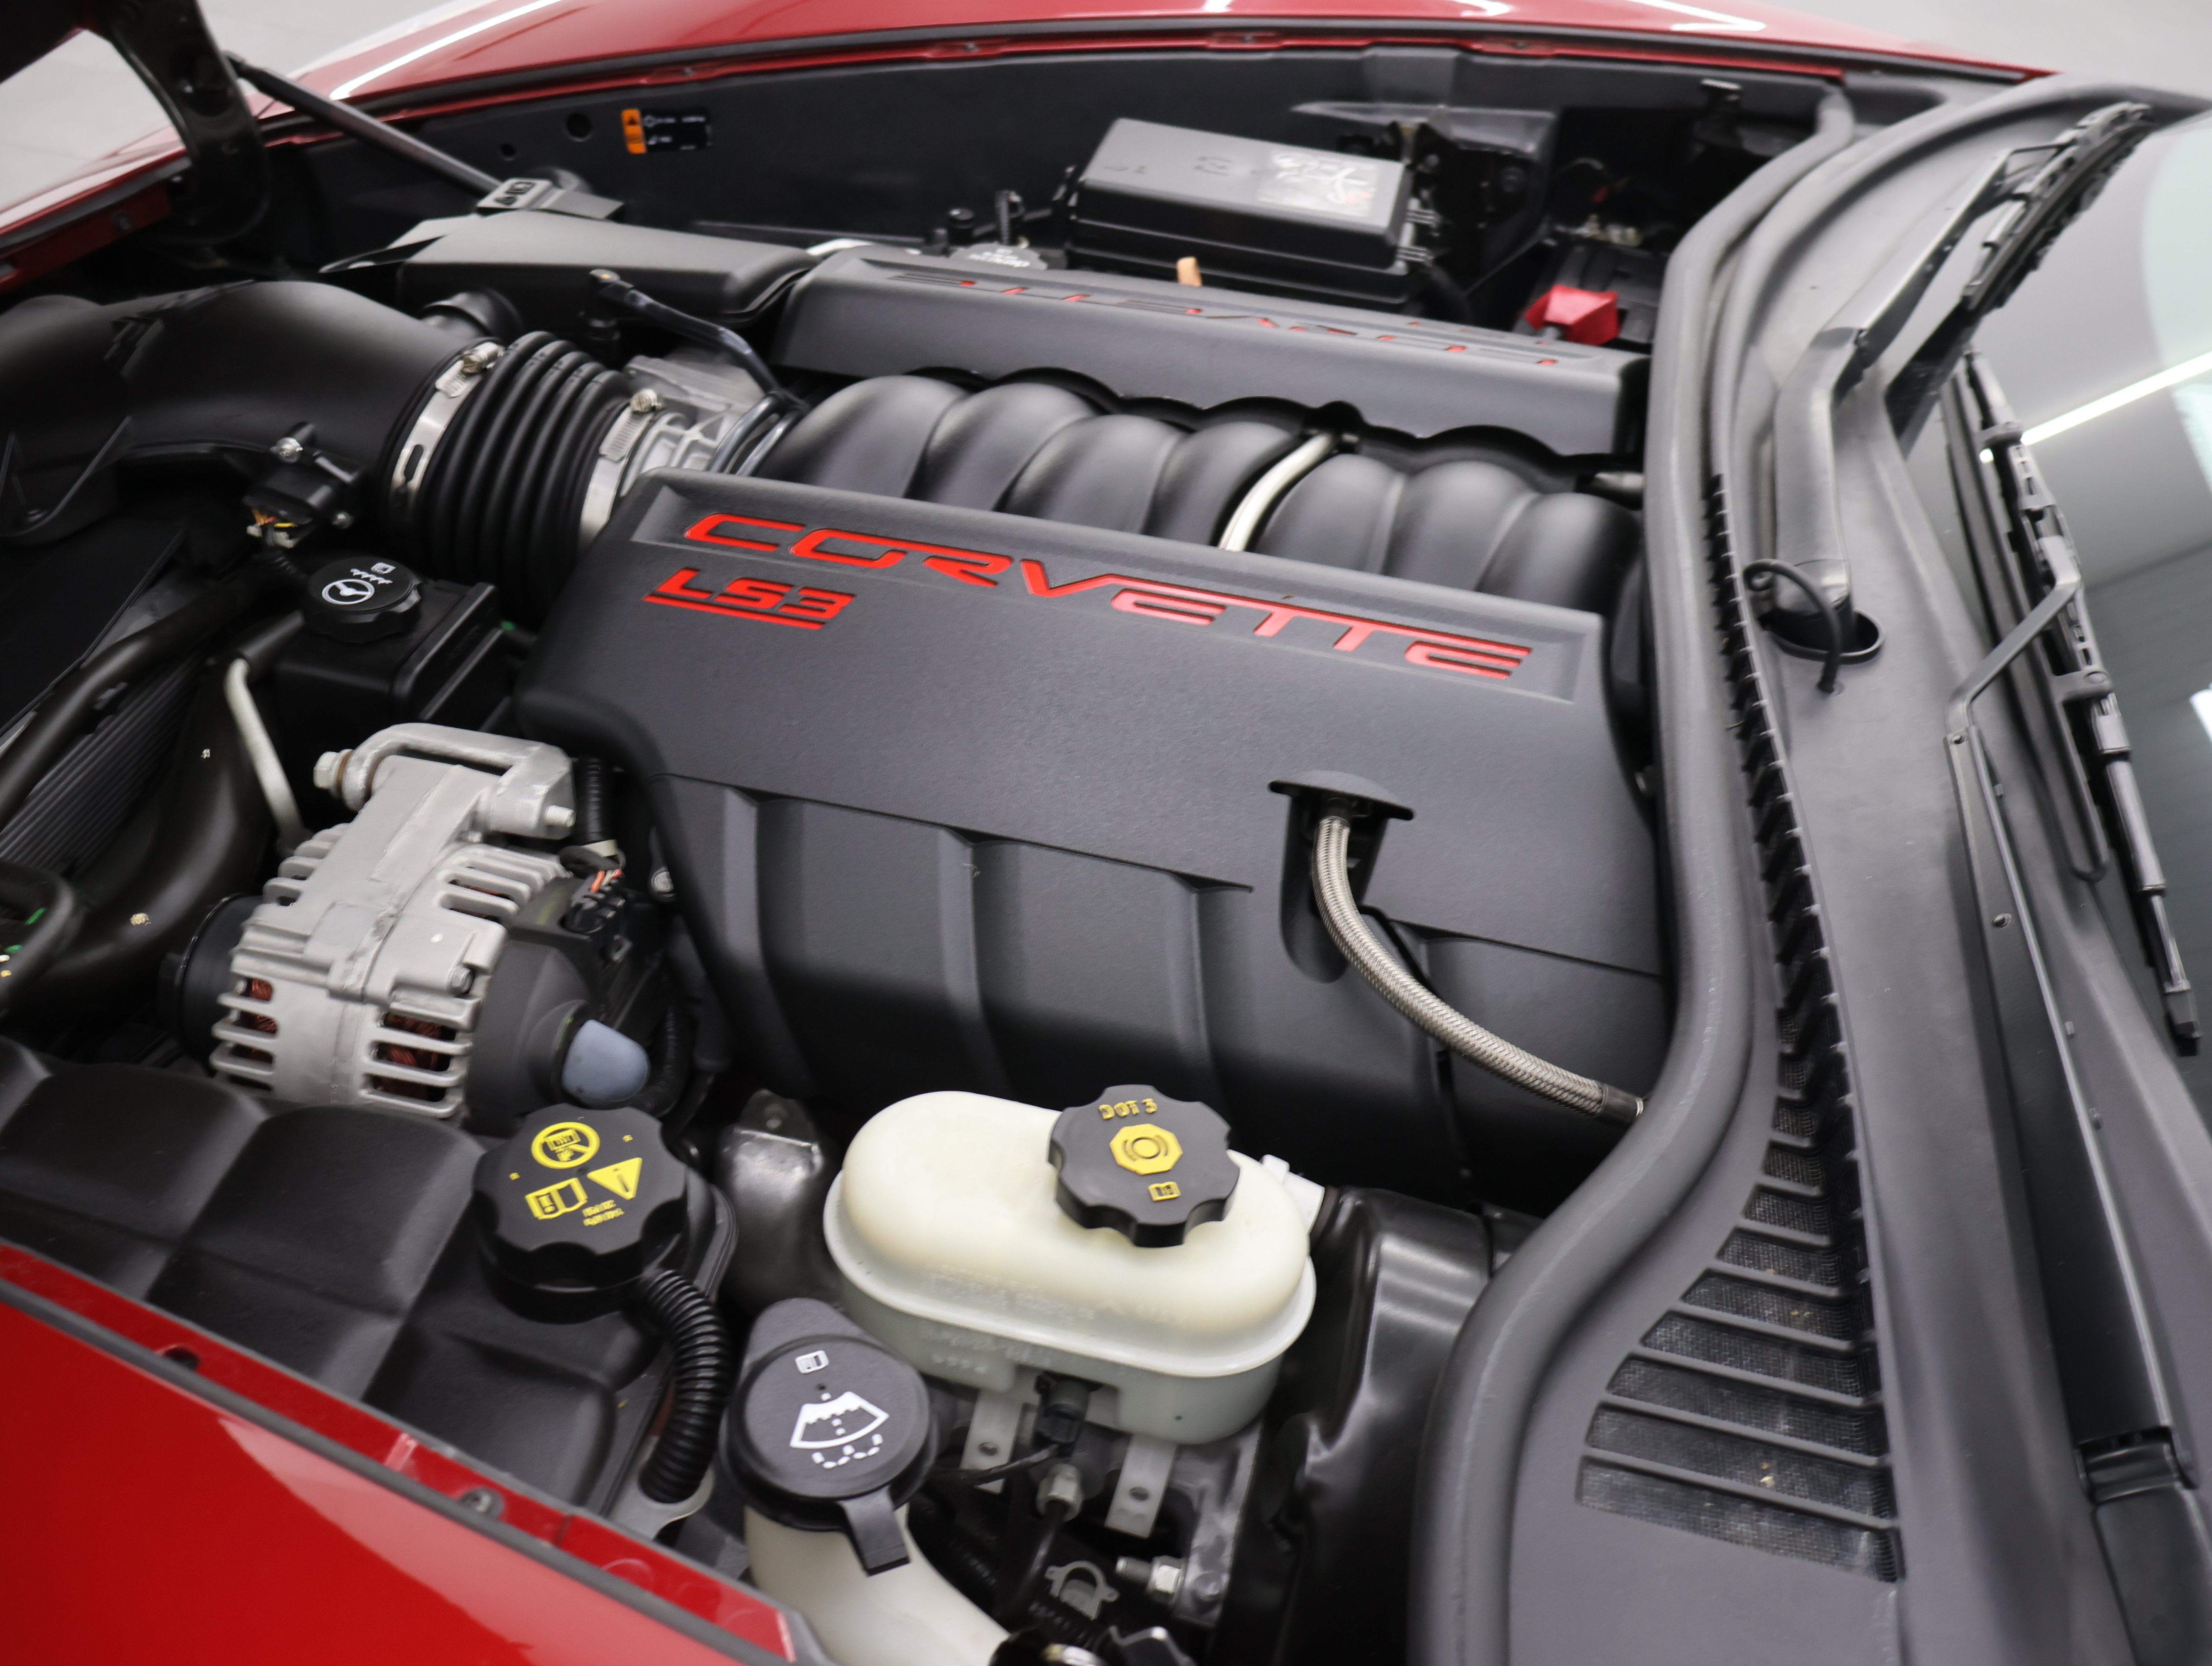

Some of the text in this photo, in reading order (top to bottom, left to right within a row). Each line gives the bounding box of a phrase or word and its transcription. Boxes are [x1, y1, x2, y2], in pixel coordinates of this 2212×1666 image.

[655, 568, 856, 620] LS3
[684, 513, 1532, 680] CORVETTE
[1098, 1098, 1157, 1120] DOT 3
